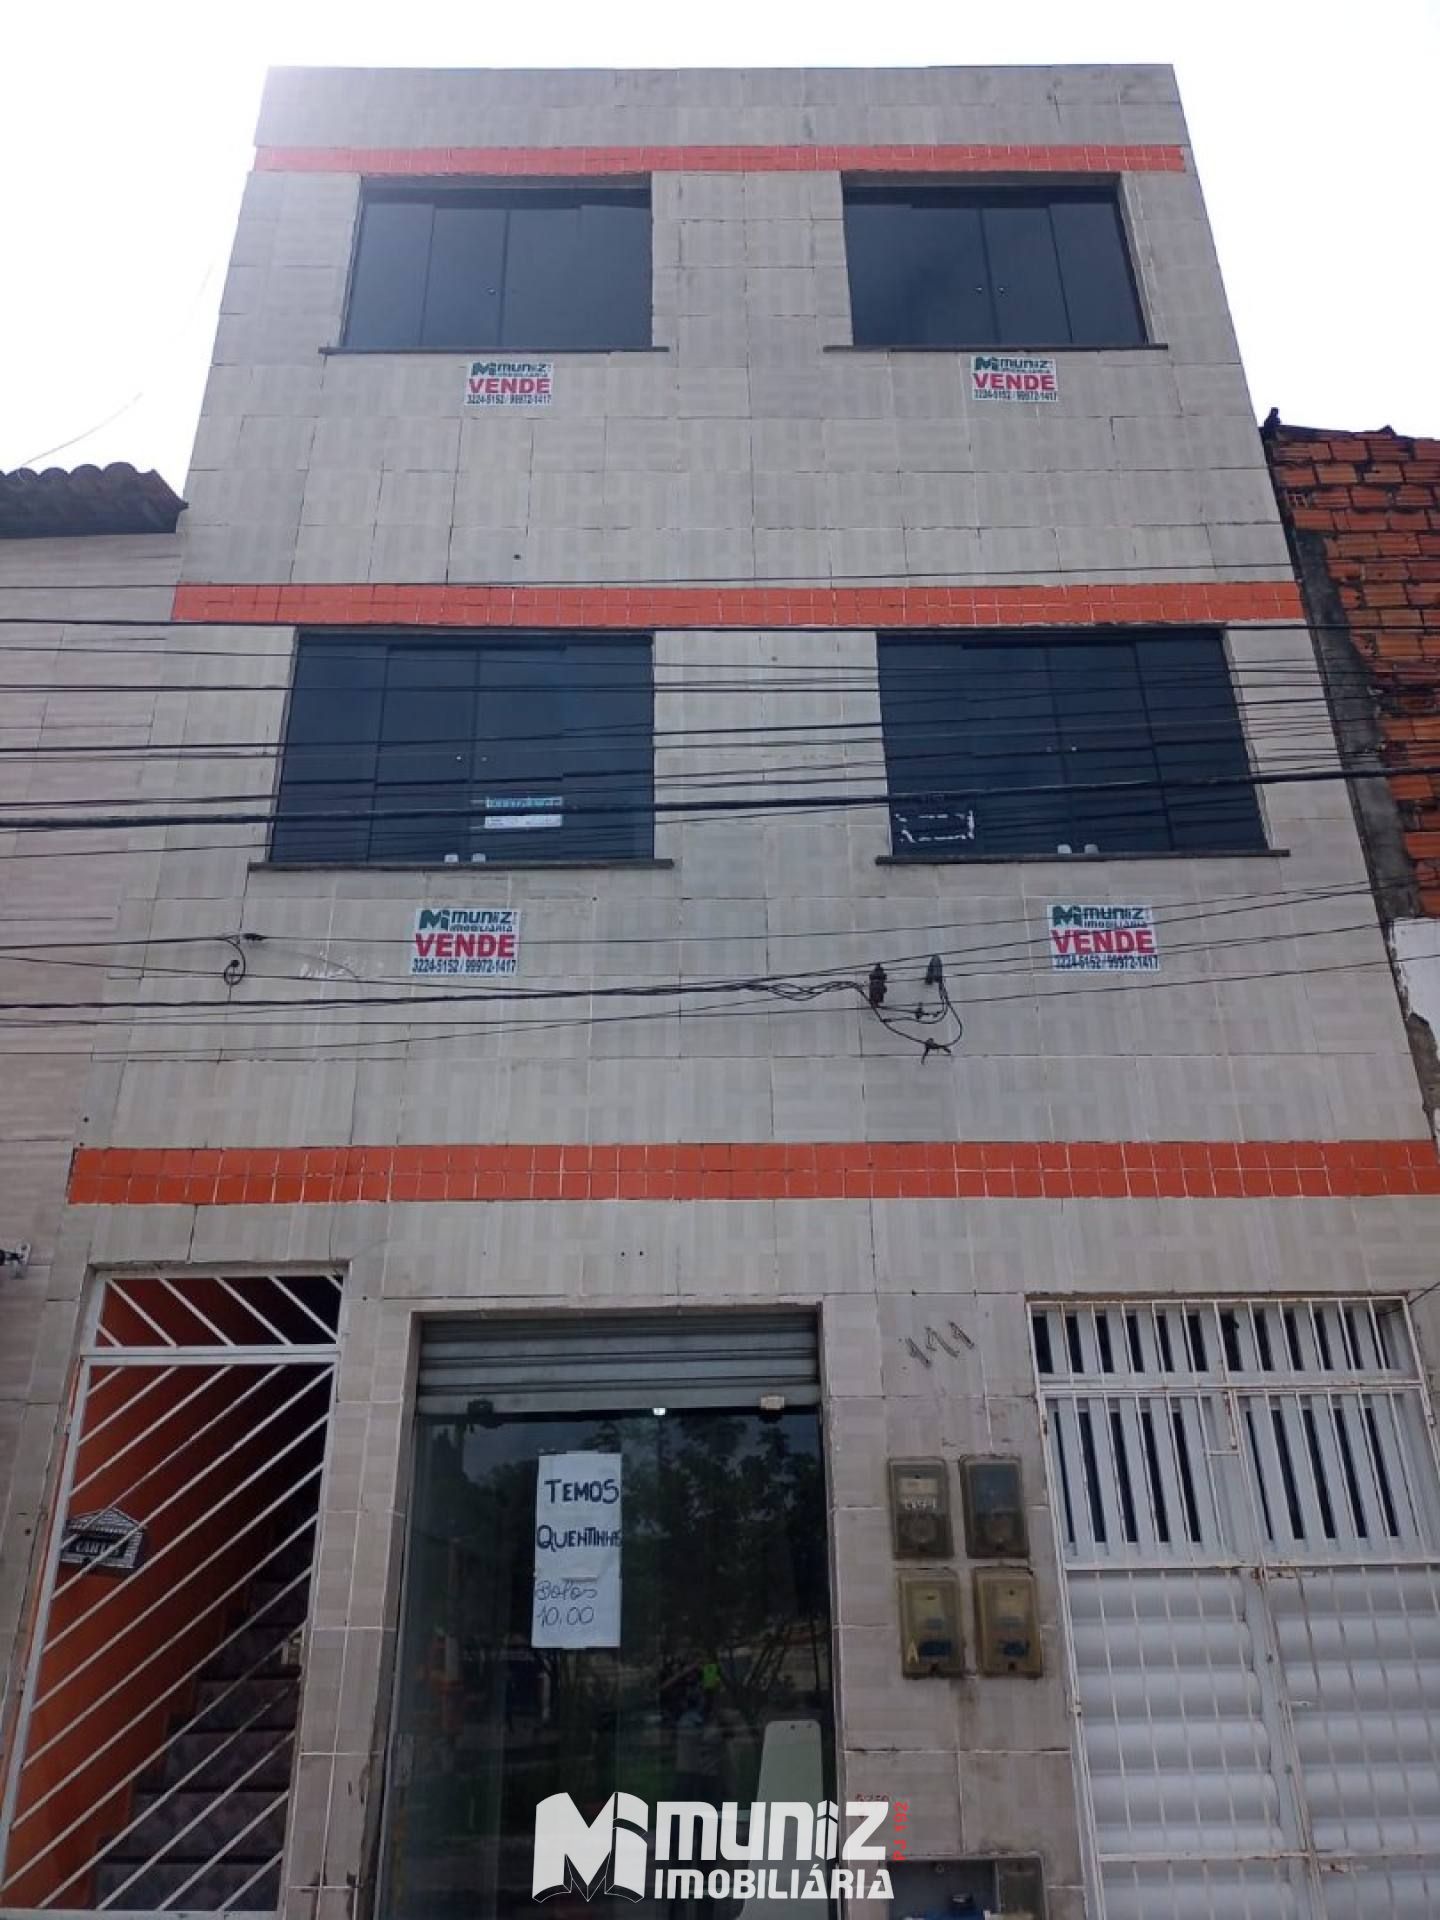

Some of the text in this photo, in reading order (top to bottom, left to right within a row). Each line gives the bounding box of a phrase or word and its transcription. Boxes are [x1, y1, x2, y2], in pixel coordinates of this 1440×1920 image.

[469, 378, 551, 394] VENDE
[974, 373, 1055, 390] VENDE
[416, 933, 514, 957] VENDE
[1051, 929, 1154, 954] VENDE
[544, 1479, 620, 1504] TEMOS
